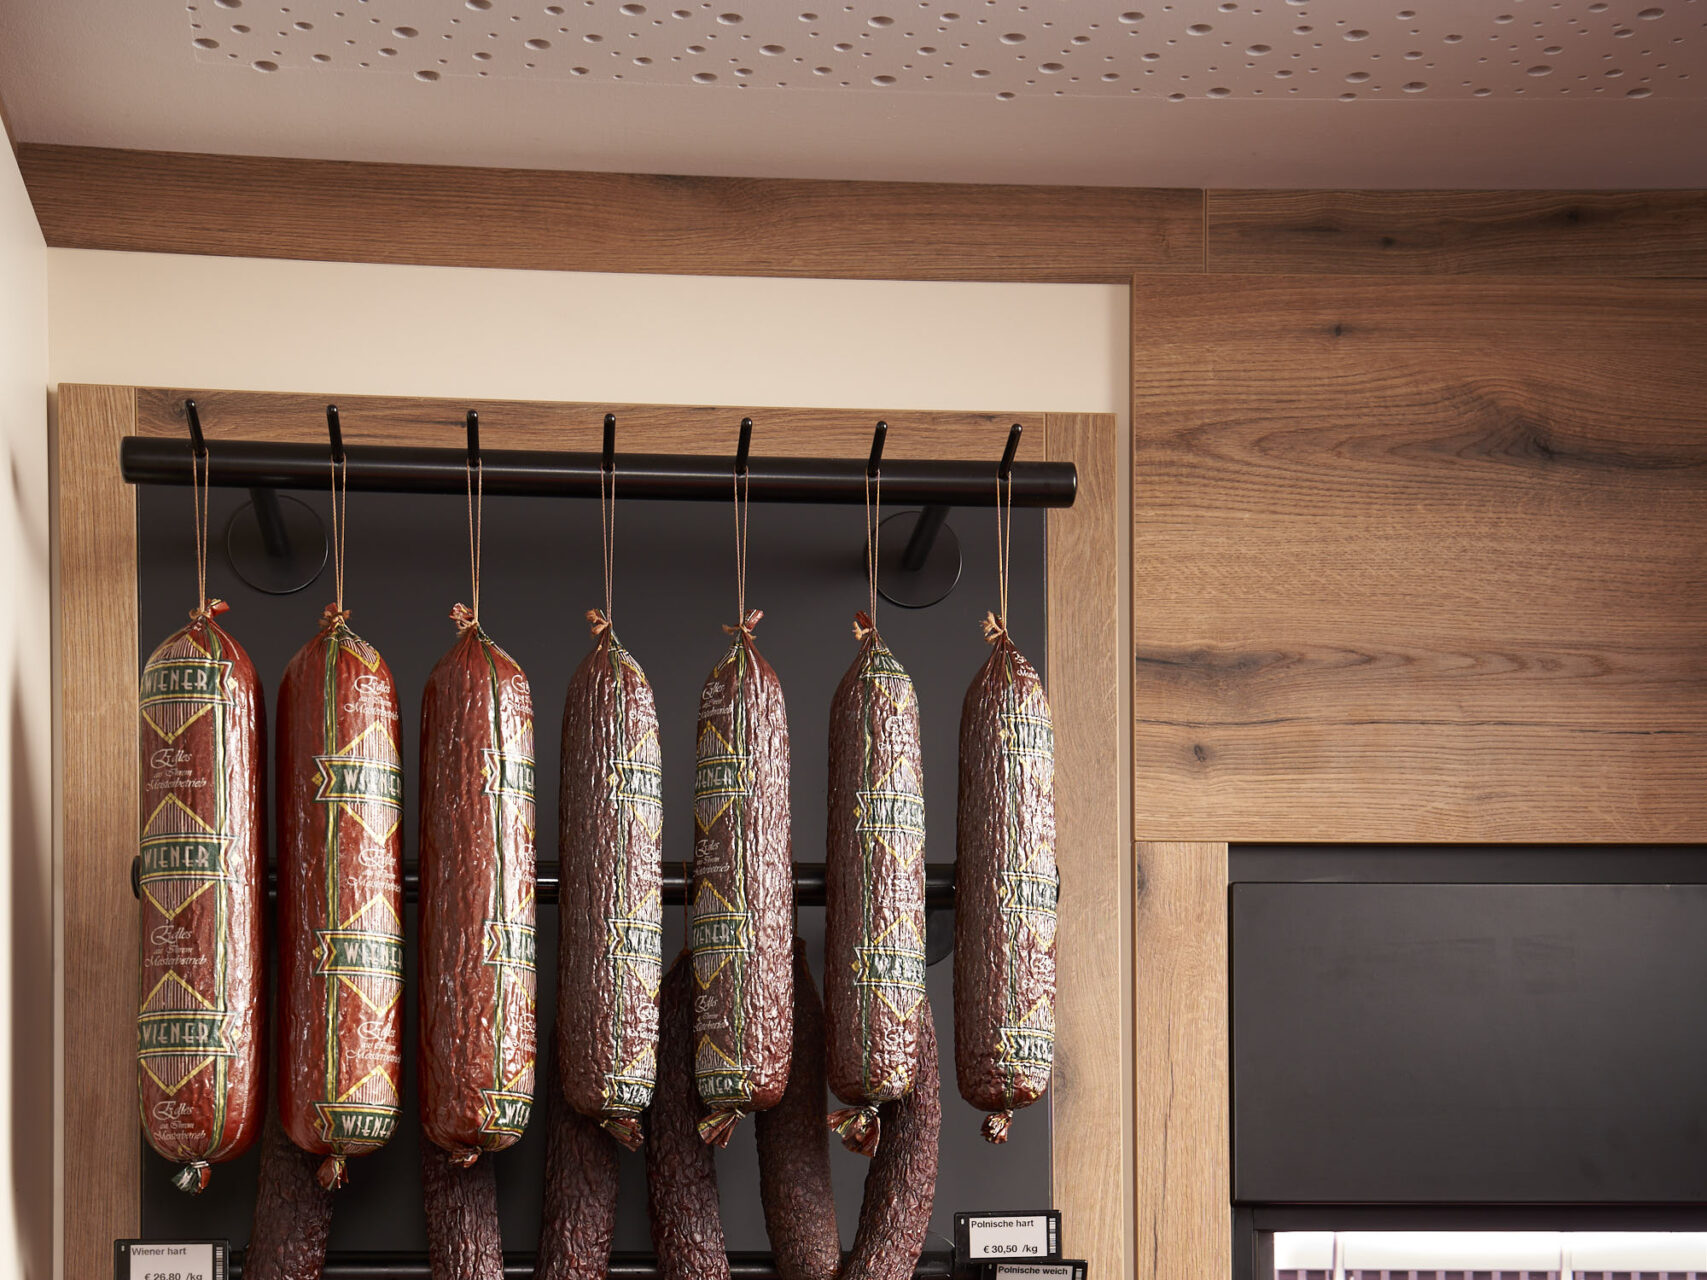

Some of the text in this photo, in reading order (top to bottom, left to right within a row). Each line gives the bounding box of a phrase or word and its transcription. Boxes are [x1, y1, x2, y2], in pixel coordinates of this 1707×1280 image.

[143, 669, 208, 694] WIENER
[150, 748, 192, 769] Edles
[143, 844, 209, 869] WIENER
[150, 925, 193, 946] Edles
[143, 1022, 209, 1044] WIENER
[153, 1101, 194, 1120] Edles
[971, 1219, 1034, 1228] Polnische hart
[131, 1247, 187, 1256] Wiener hart
[983, 1244, 1038, 1254] € 30,50 /kg
[144, 1273, 152, 1280] €
[998, 1266, 1068, 1275] Polnische weich
